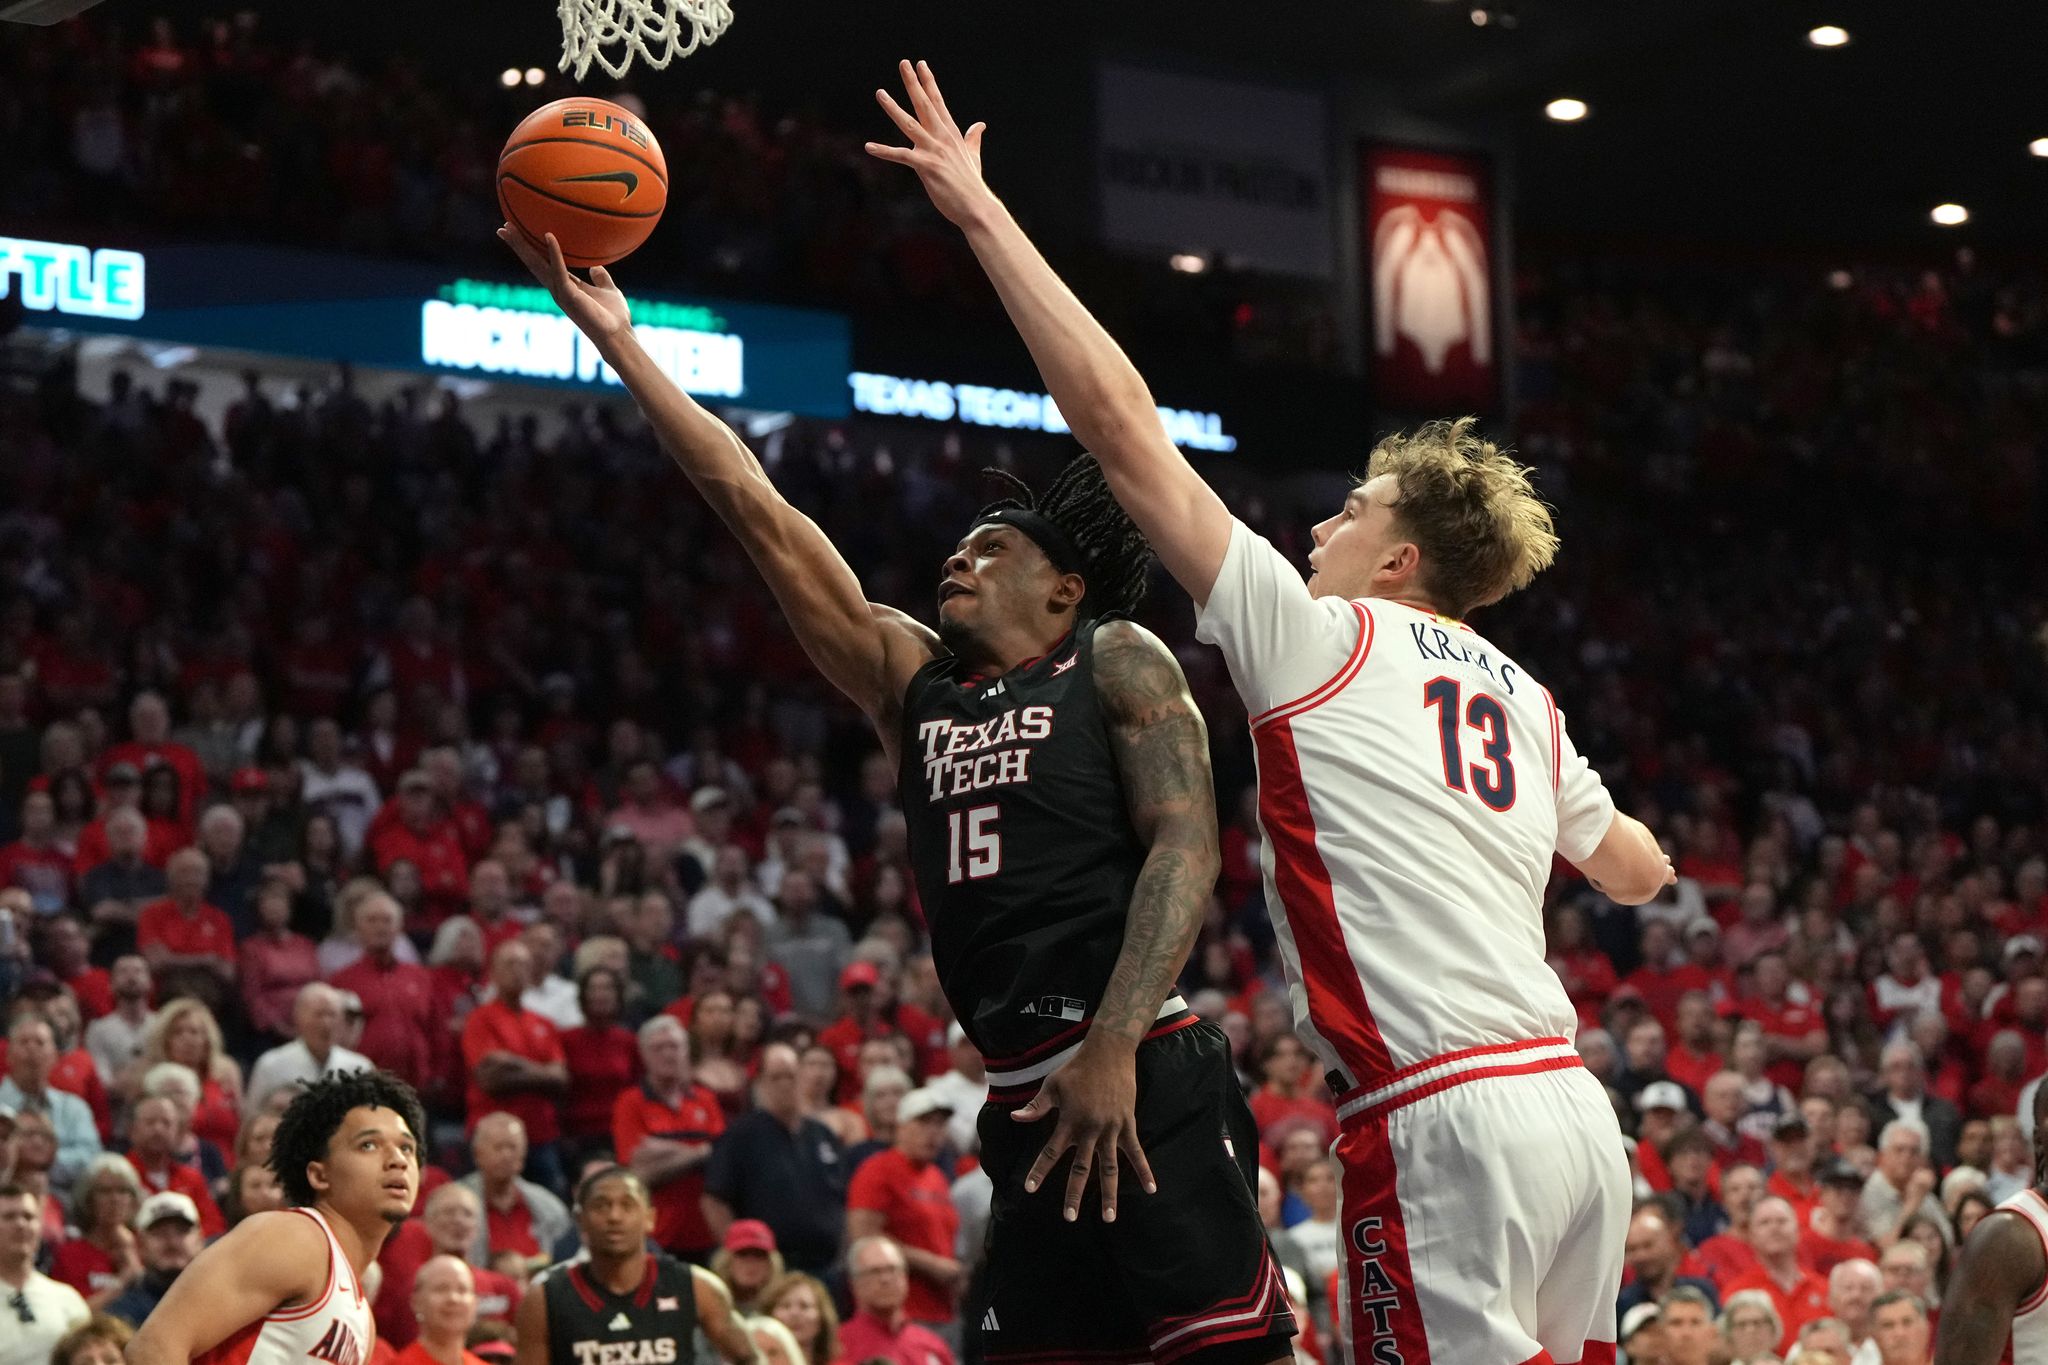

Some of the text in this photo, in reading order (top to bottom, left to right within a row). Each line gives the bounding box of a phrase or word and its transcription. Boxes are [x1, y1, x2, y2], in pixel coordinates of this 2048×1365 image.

[562, 108, 649, 151] ELITE
[848, 372, 955, 421] TEXAS
[955, 384, 1042, 430] TECH
[918, 705, 1054, 764] TEXAS
[1423, 675, 1517, 813] 13
[925, 748, 1031, 803] TECH
[948, 803, 1002, 885] 15
[1352, 1216, 1405, 1365] CATS
[572, 1337, 677, 1365] TEXAS
